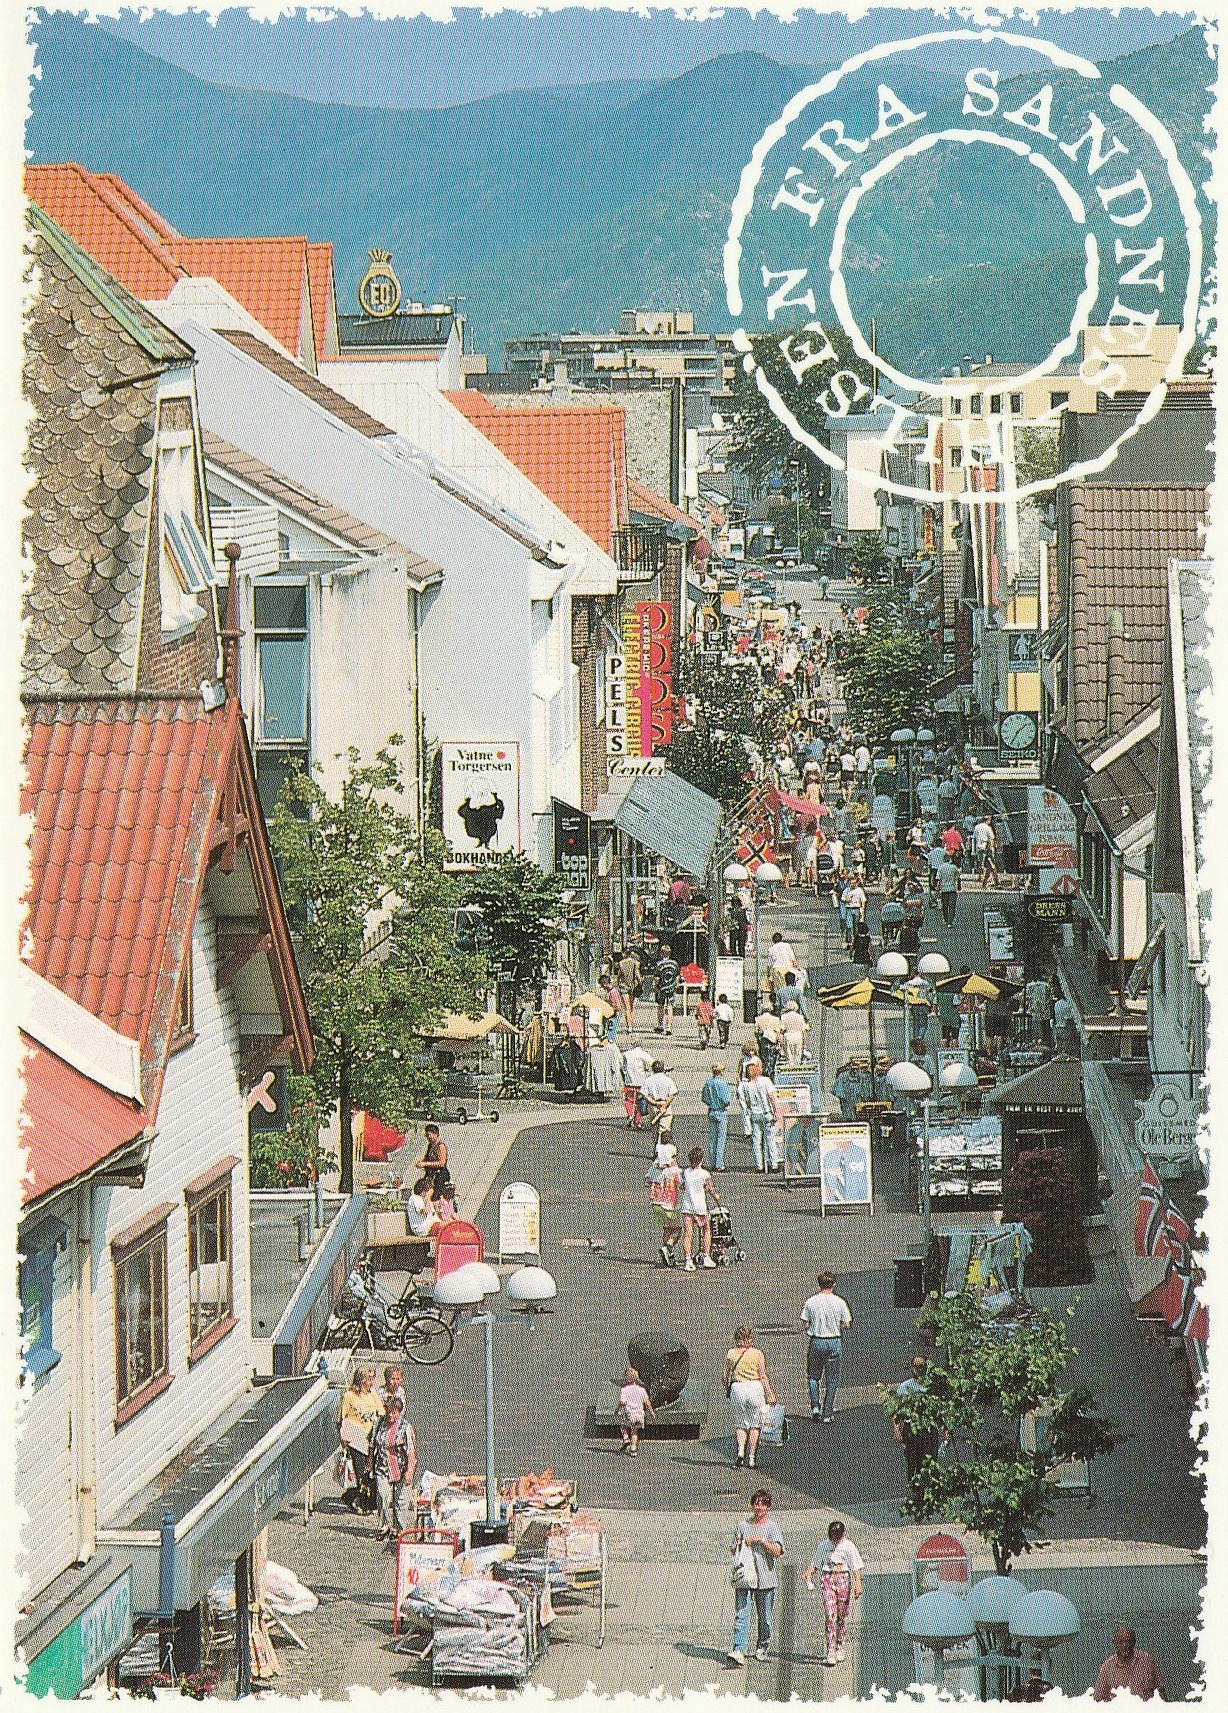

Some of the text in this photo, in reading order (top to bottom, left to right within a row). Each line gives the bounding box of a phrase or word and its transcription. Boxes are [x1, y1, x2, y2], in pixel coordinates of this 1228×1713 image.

[623, 613, 642, 691] ELECTRIC
[609, 656, 623, 753] PELS
[457, 748, 494, 760] Vatne
[1000, 749, 1038, 759] SEIKO
[449, 760, 512, 773] Torgersen
[607, 757, 665, 777] Center
[1035, 902, 1067, 910] DRESS
[1035, 910, 1067, 918] MANN
[1141, 1129, 1162, 1145] Ole
